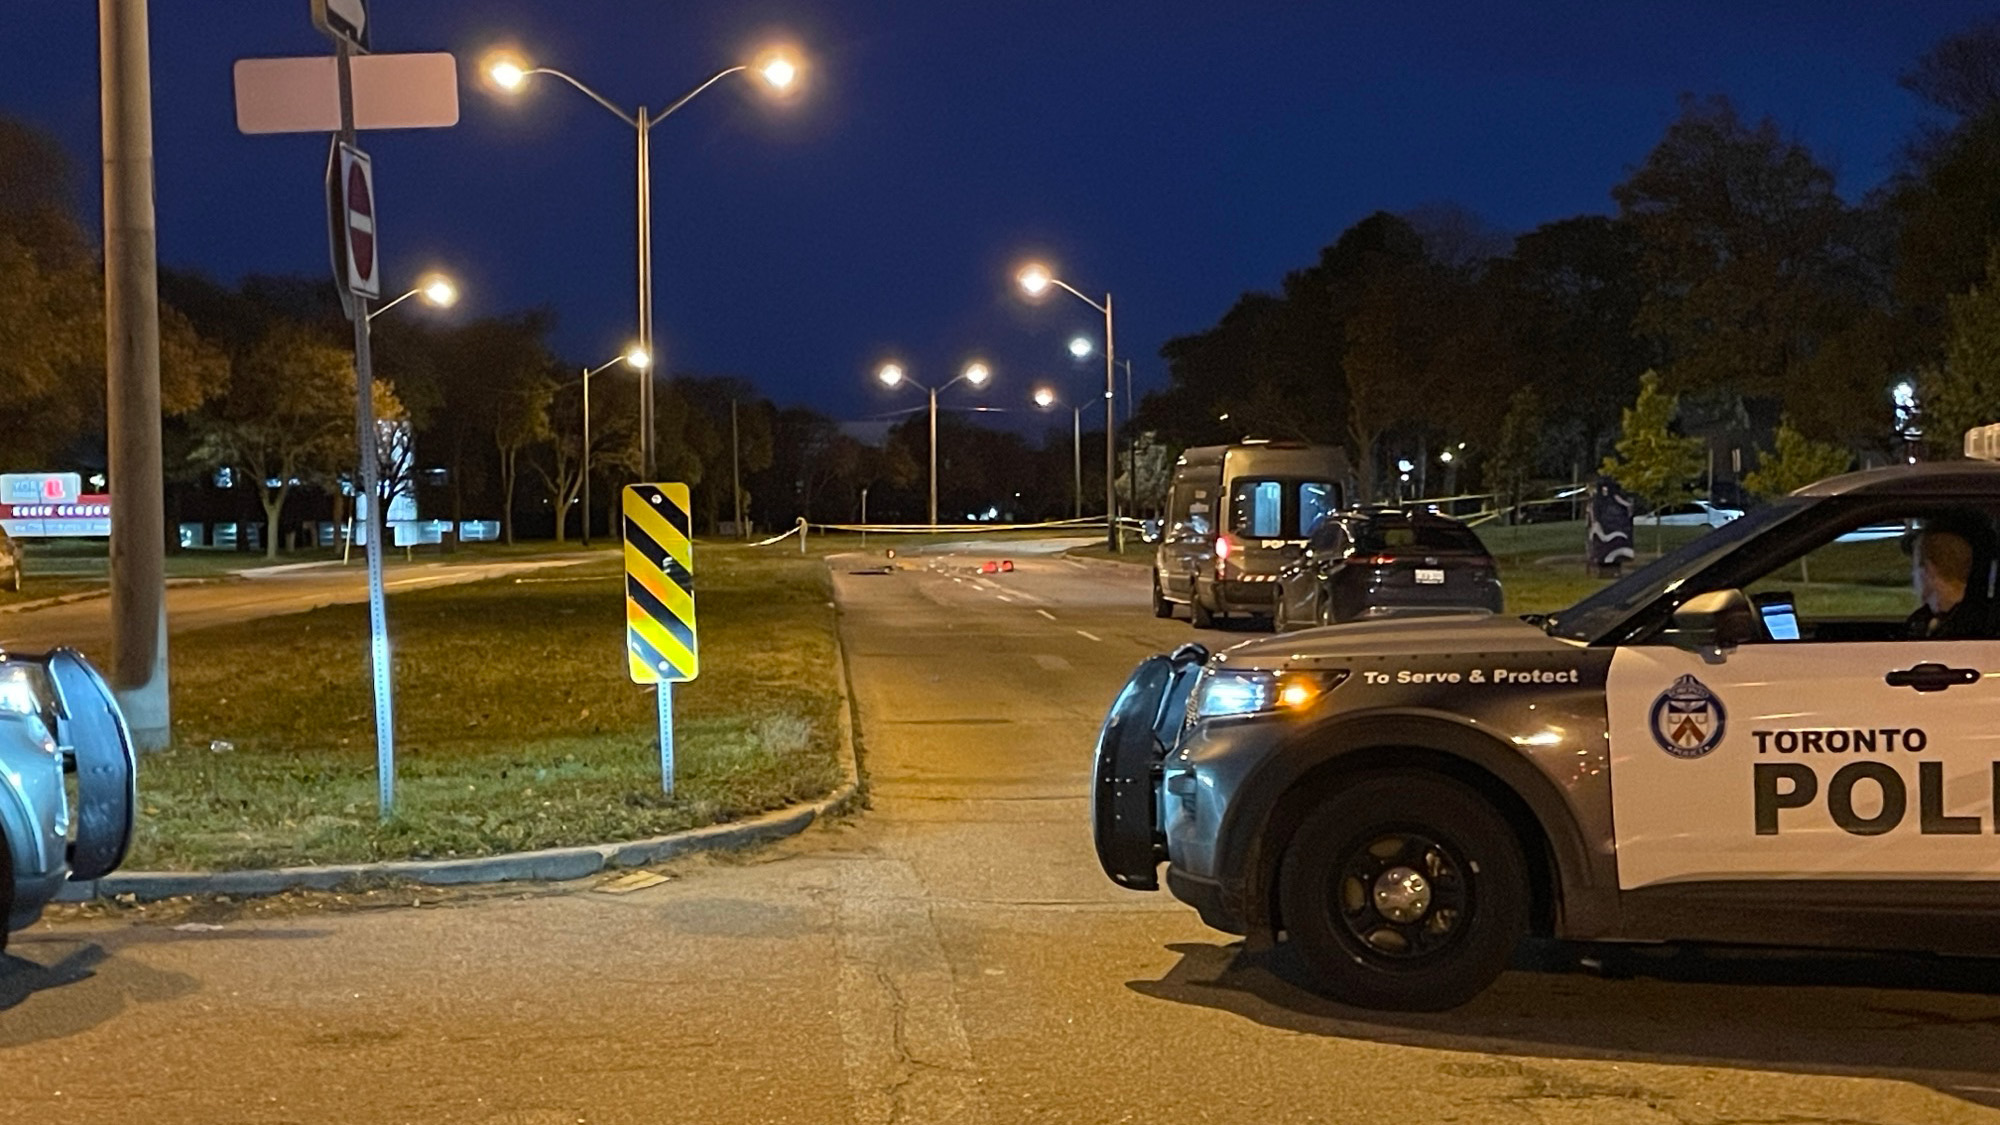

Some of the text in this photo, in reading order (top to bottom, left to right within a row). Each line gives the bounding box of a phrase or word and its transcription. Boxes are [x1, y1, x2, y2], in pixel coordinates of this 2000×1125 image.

[1363, 669, 1579, 684] To Serve & Protect
[1752, 728, 1927, 753] TORONTO
